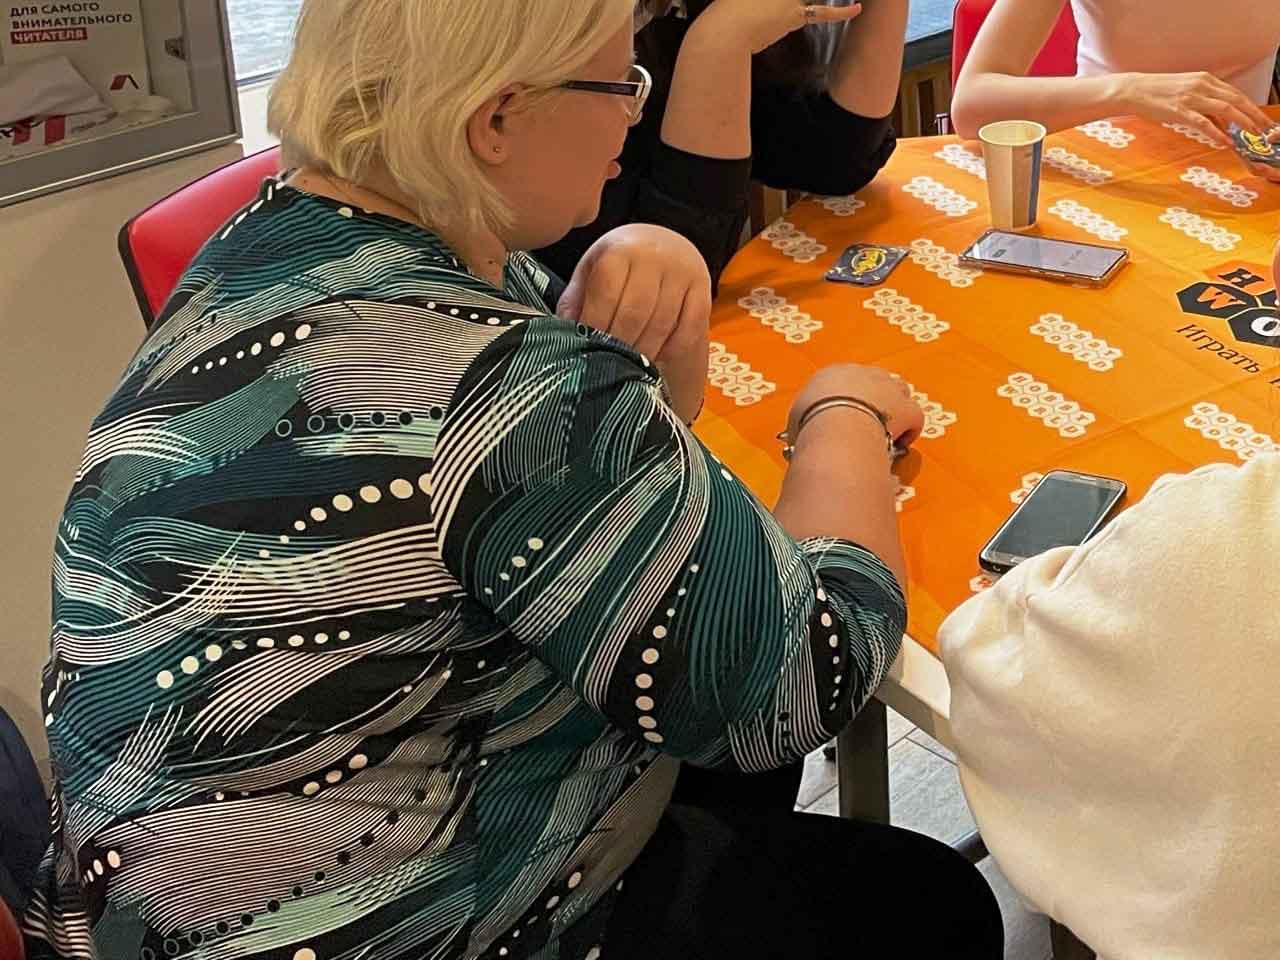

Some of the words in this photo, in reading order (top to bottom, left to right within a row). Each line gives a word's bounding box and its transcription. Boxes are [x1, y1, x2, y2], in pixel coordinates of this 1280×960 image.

[10, 6, 38, 18] ДЛЯ
[41, 2, 100, 15] САМОГО
[12, 13, 133, 29] ВНИМАТЕЛЬНОГО
[13, 29, 85, 43] ЧИТАТЕЛЯ
[1176, 323, 1261, 374] Играть
[1002, 385, 1079, 434] WORLD
[1013, 374, 1088, 422] HOBBY
